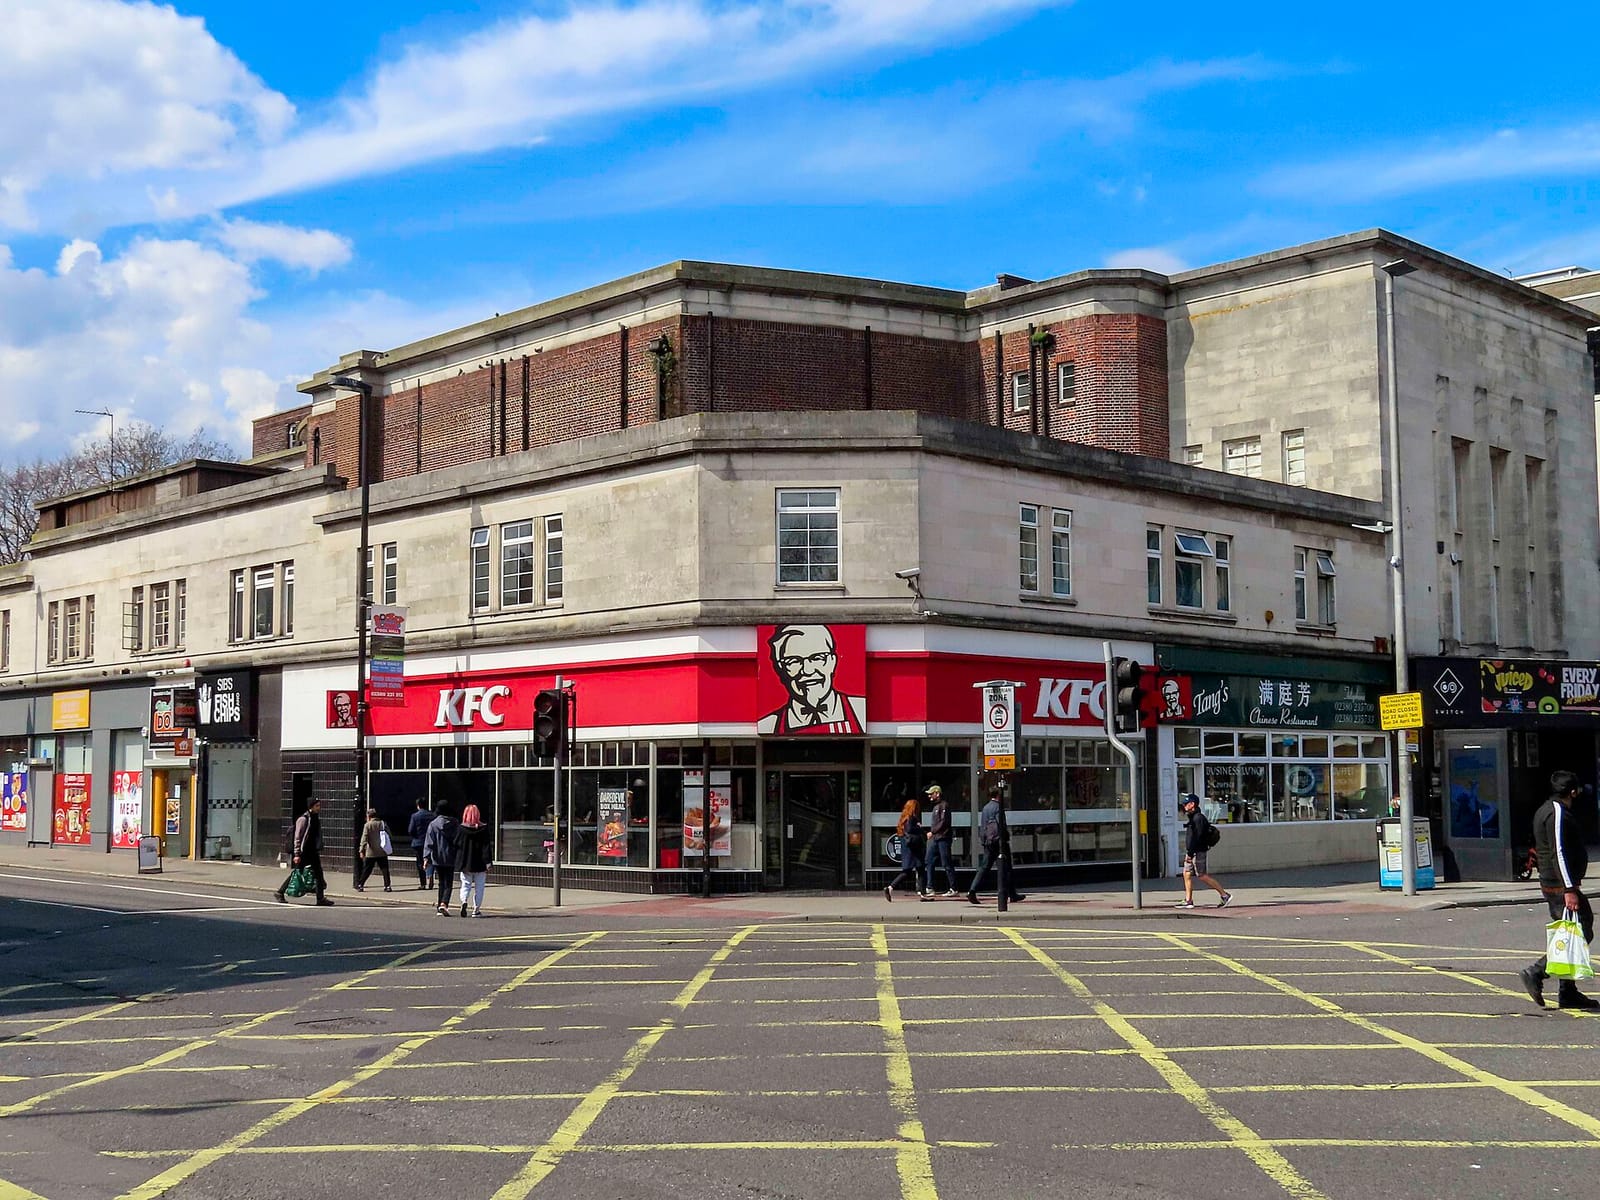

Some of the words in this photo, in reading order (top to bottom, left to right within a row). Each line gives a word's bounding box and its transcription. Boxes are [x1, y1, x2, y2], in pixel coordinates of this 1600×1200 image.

[1494, 664, 1534, 692] JUICED
[1562, 667, 1597, 683] EVERY
[217, 678, 233, 691] SIBS
[1560, 683, 1600, 699] FRIDAY
[214, 692, 235, 708] FISH
[434, 685, 505, 727] KFC
[988, 694, 1008, 702] ZONE
[1193, 680, 1229, 716] Tang's
[213, 706, 241, 723] CHIPS
[1249, 706, 1278, 725] Chinese
[1279, 707, 1319, 726] Restaurant
[1206, 766, 1240, 776] BUSINESS
[599, 792, 626, 803] DAREDEVIL
[119, 803, 140, 815] MEAT
